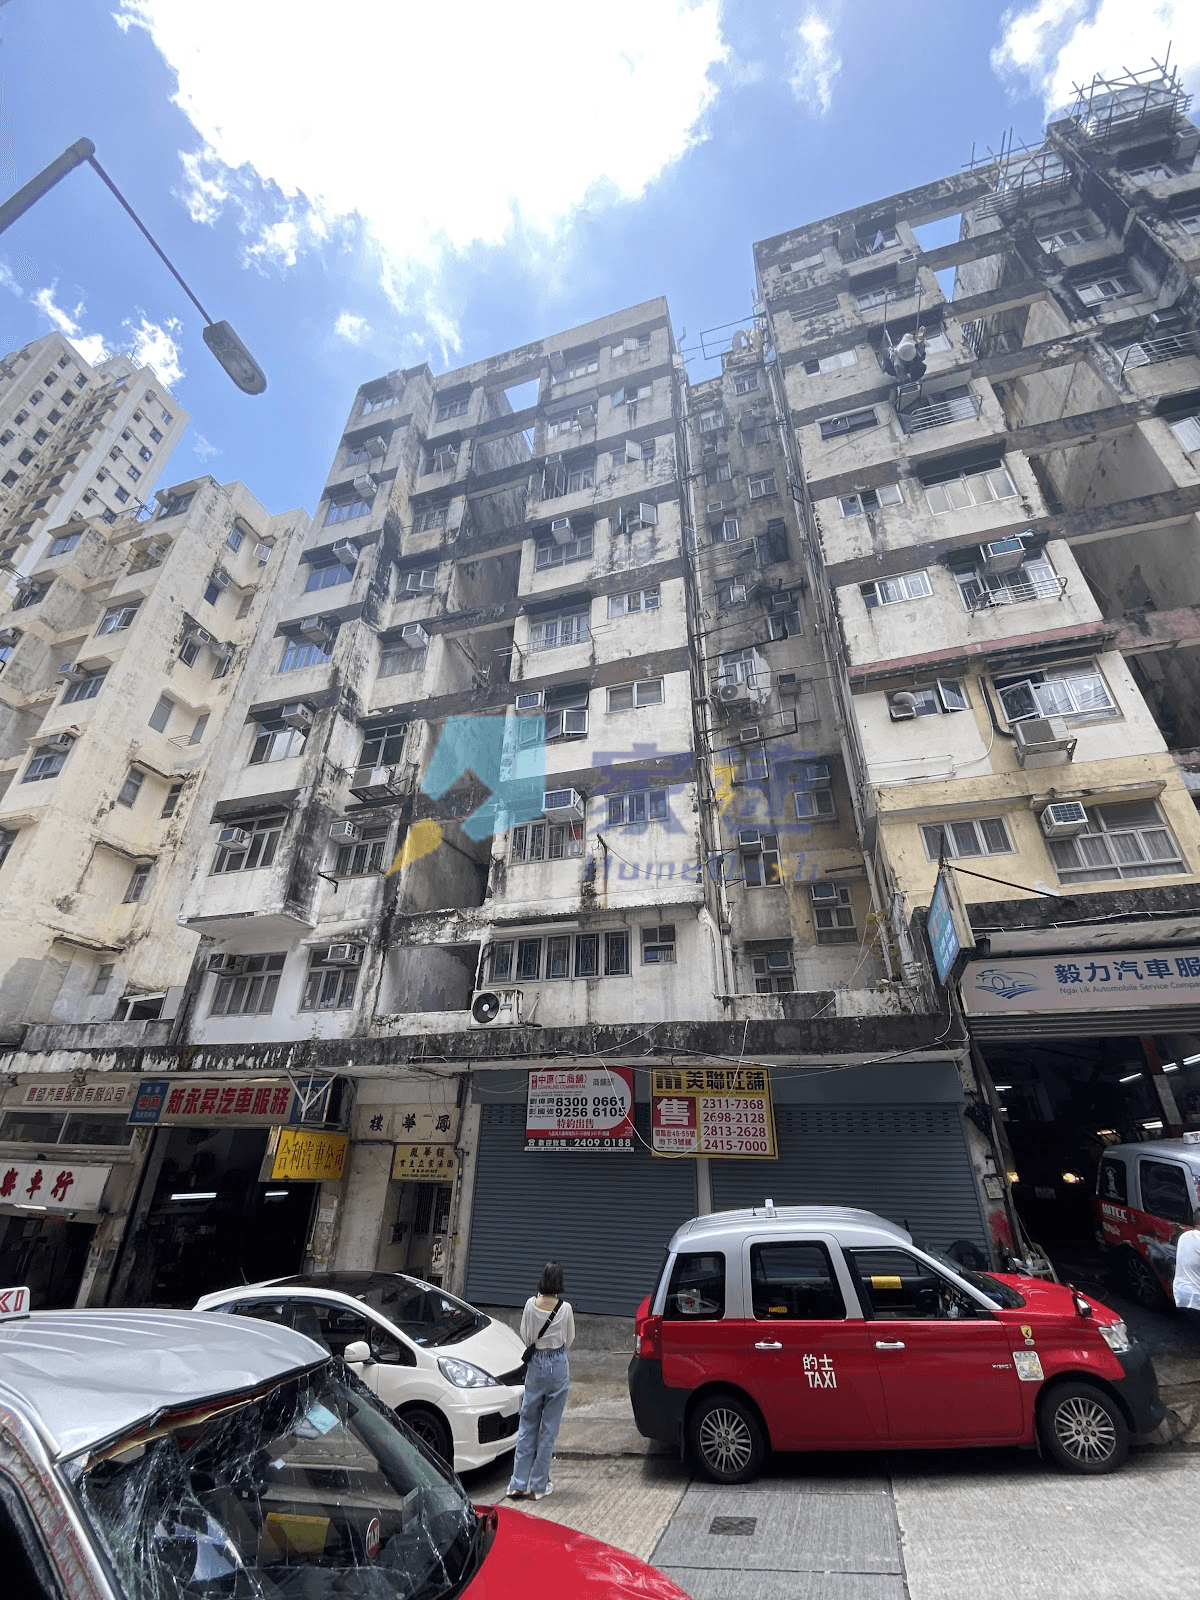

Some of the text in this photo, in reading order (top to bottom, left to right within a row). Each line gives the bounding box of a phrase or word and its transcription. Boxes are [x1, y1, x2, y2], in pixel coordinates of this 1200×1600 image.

[1060, 987, 1078, 995] Ngai
[1080, 985, 1091, 993] Lik
[1093, 984, 1138, 992] Automobile
[1140, 982, 1169, 990] Service
[686, 1070, 765, 1090] 美聯旺舖
[165, 1087, 291, 1114] 新永昇汽車服務
[555, 1097, 588, 1107] 8300
[592, 1096, 626, 1107] 0661
[702, 1098, 764, 1109] 2311-7368
[555, 1108, 588, 1117] 9256
[592, 1107, 626, 1117] 6105
[657, 1098, 690, 1125] 售
[703, 1112, 765, 1123] 2698-2128
[703, 1126, 766, 1137] 2813-2628
[574, 1138, 600, 1147] 2409
[604, 1138, 631, 1147] 0188
[704, 1140, 767, 1151] 2415-7000
[803, 1354, 833, 1370] 的士
[804, 1371, 837, 1388] TAXI
